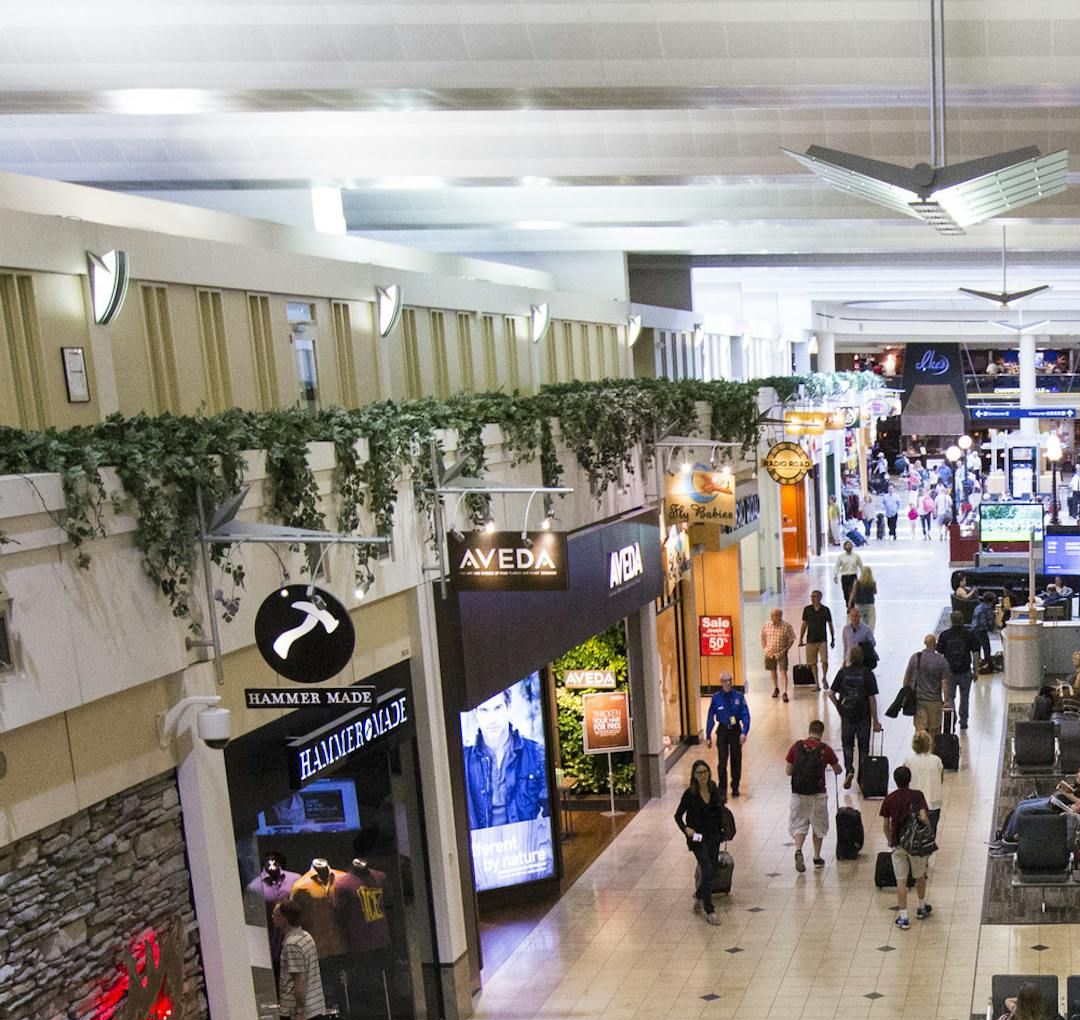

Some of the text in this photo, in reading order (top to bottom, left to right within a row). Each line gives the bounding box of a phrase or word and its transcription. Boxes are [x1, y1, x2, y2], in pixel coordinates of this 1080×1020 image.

[669, 503, 689, 521] Fly
[691, 503, 733, 520] Babies
[459, 548, 556, 569] AVEDA
[610, 542, 643, 589] AVEDA
[702, 617, 730, 628] Sale
[565, 671, 616, 685] AVEDA
[248, 691, 373, 705] HAMMER MADE
[483, 857, 499, 874] by
[502, 849, 546, 868] nature
